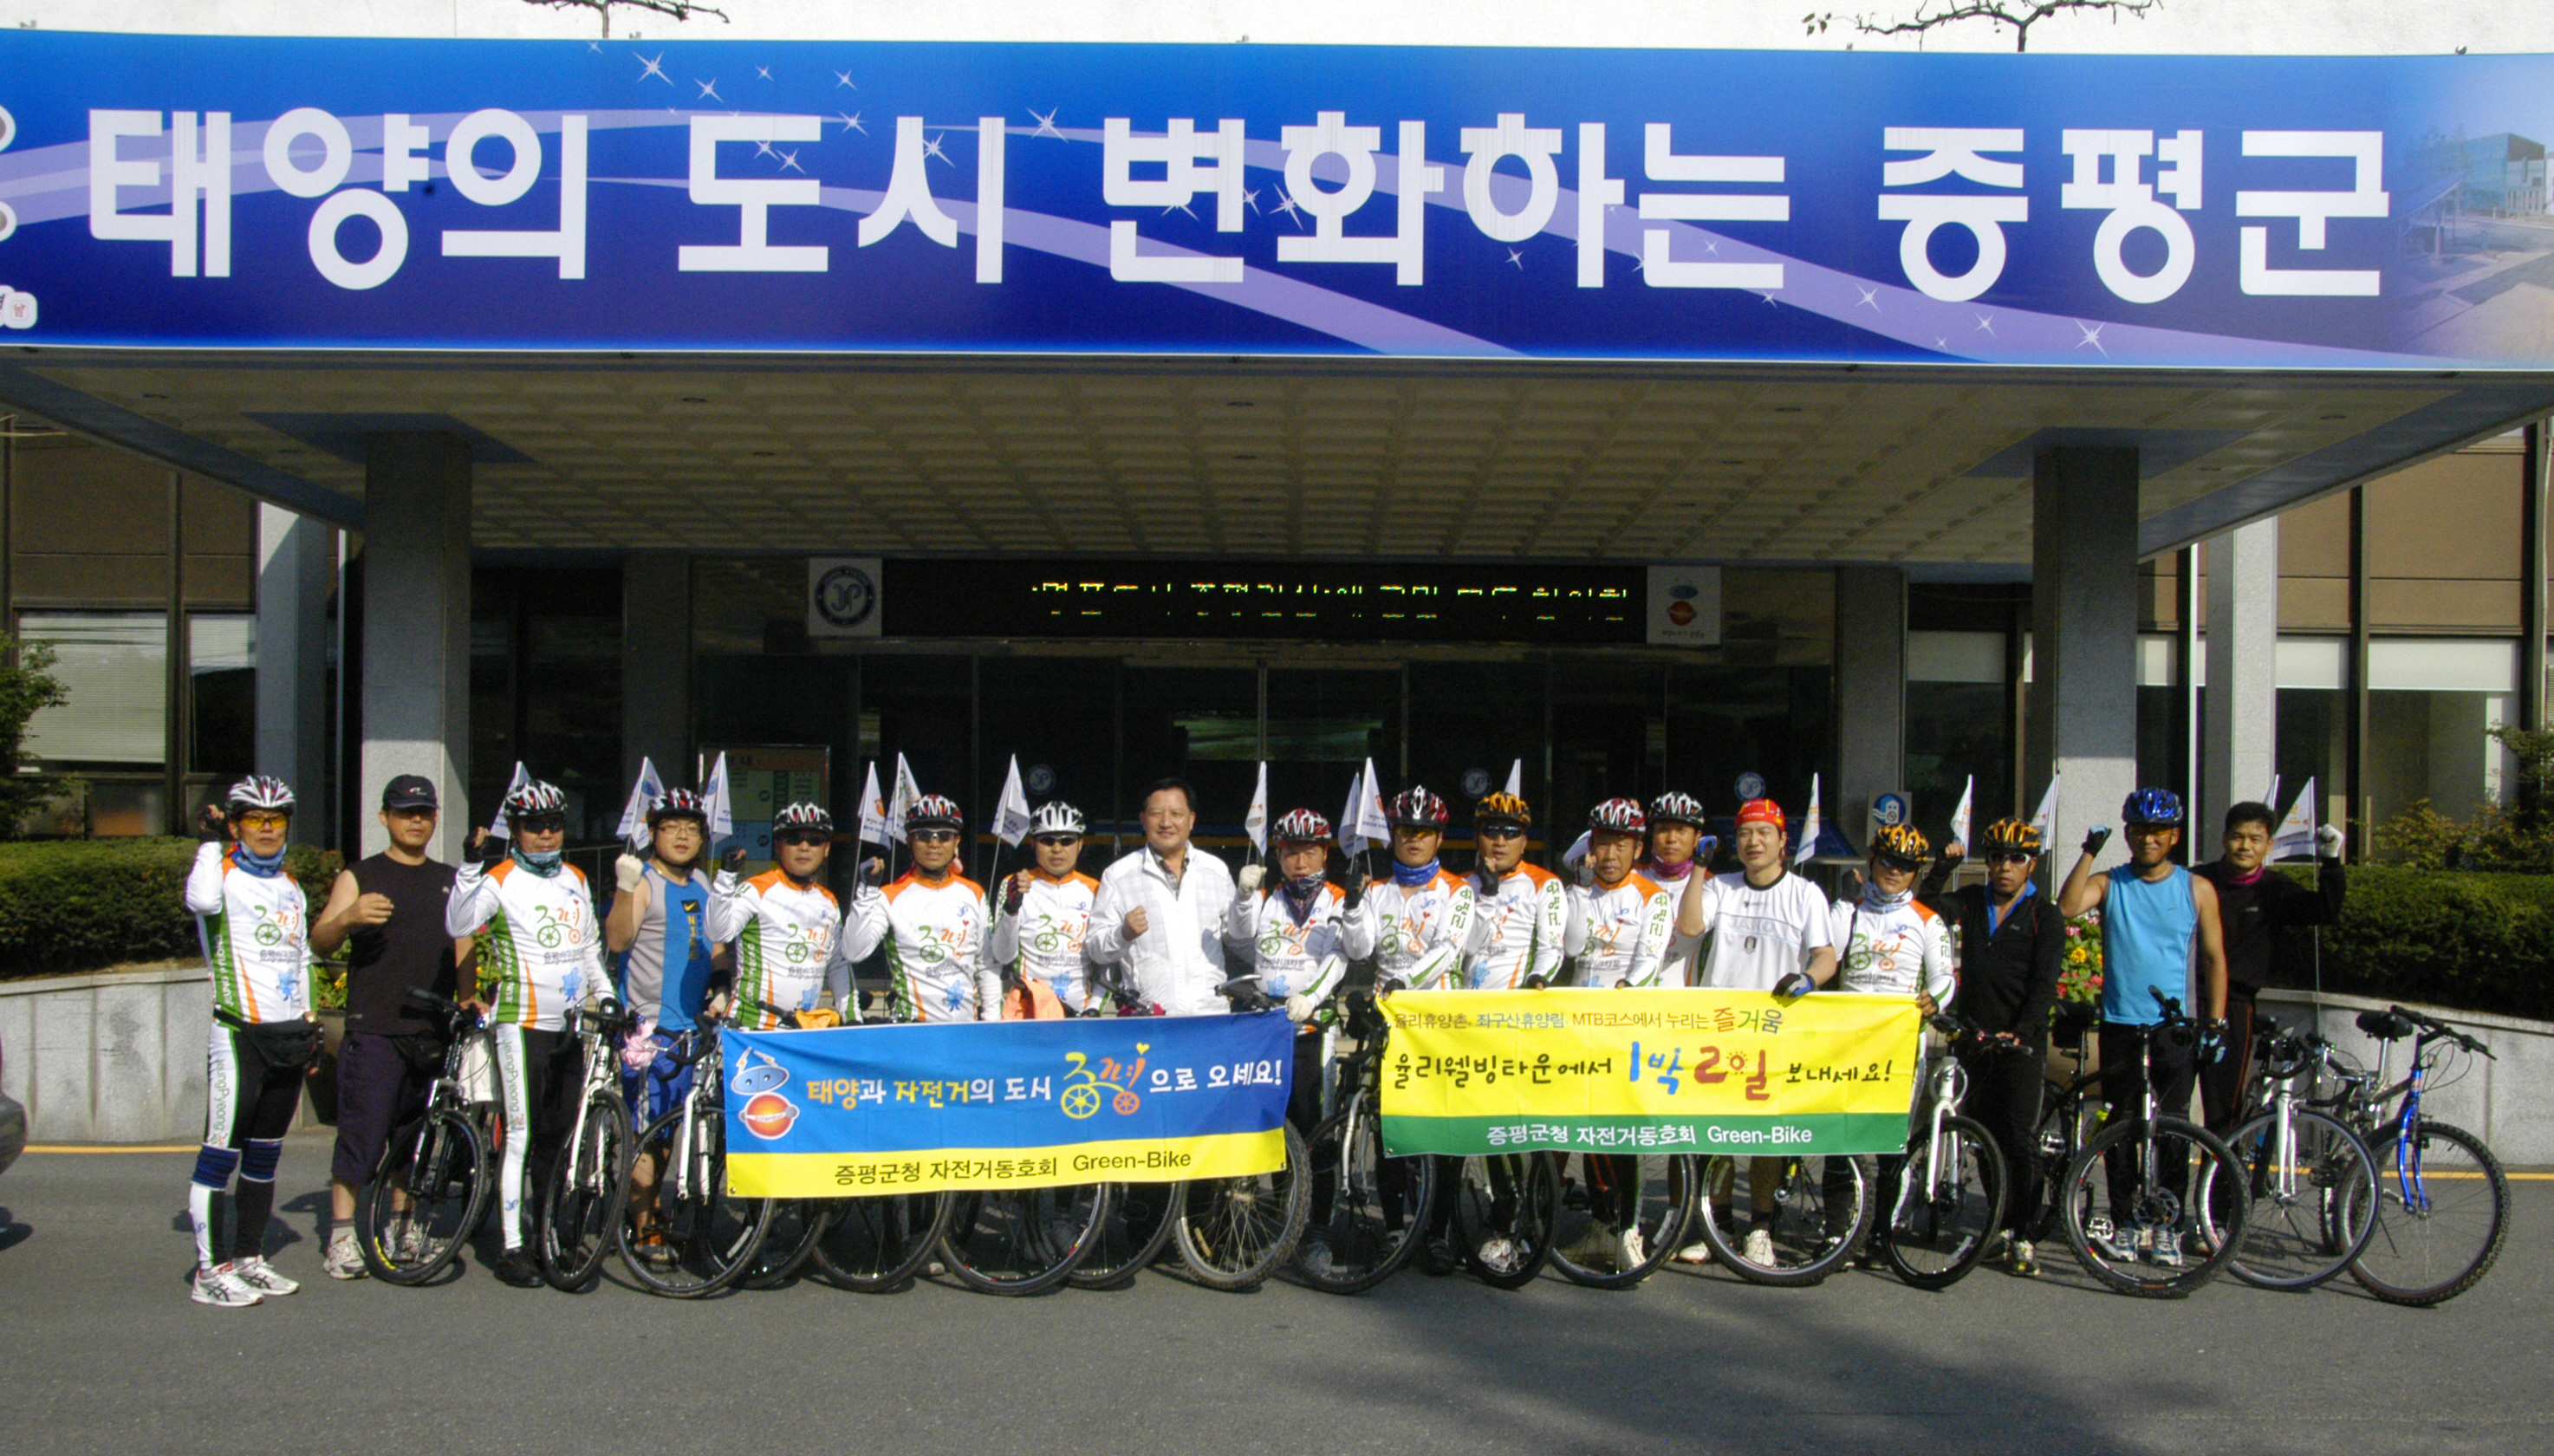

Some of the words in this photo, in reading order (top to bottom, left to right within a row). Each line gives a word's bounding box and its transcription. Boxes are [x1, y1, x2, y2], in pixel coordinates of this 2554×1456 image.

[89, 107, 587, 290] 태양의
[679, 116, 1005, 284] 도시
[1103, 111, 1790, 289] 변화하는
[1879, 127, 2389, 303] 증평군
[1573, 1012, 1661, 1029] MTB코스에서
[1666, 1012, 1709, 1030] 누리는
[1713, 1007, 1784, 1034] 즐거움
[807, 1078, 887, 1110] 태양과
[893, 1078, 994, 1108] 자전거의
[1004, 1076, 1051, 1101] 도시
[1206, 1059, 1283, 1089] 오세요!
[1394, 1054, 1612, 1089] 율리웰빙타운에서
[1786, 1059, 1892, 1083] 보내세요!
[1486, 1125, 1569, 1146] 증평군청
[1576, 1125, 1696, 1147] 자전거동호회
[1707, 1126, 1812, 1145] Green-Bike
[835, 1162, 920, 1186] 증평군청
[930, 1157, 1056, 1180] 자전거동호회
[1073, 1151, 1192, 1172] Green-Bike
